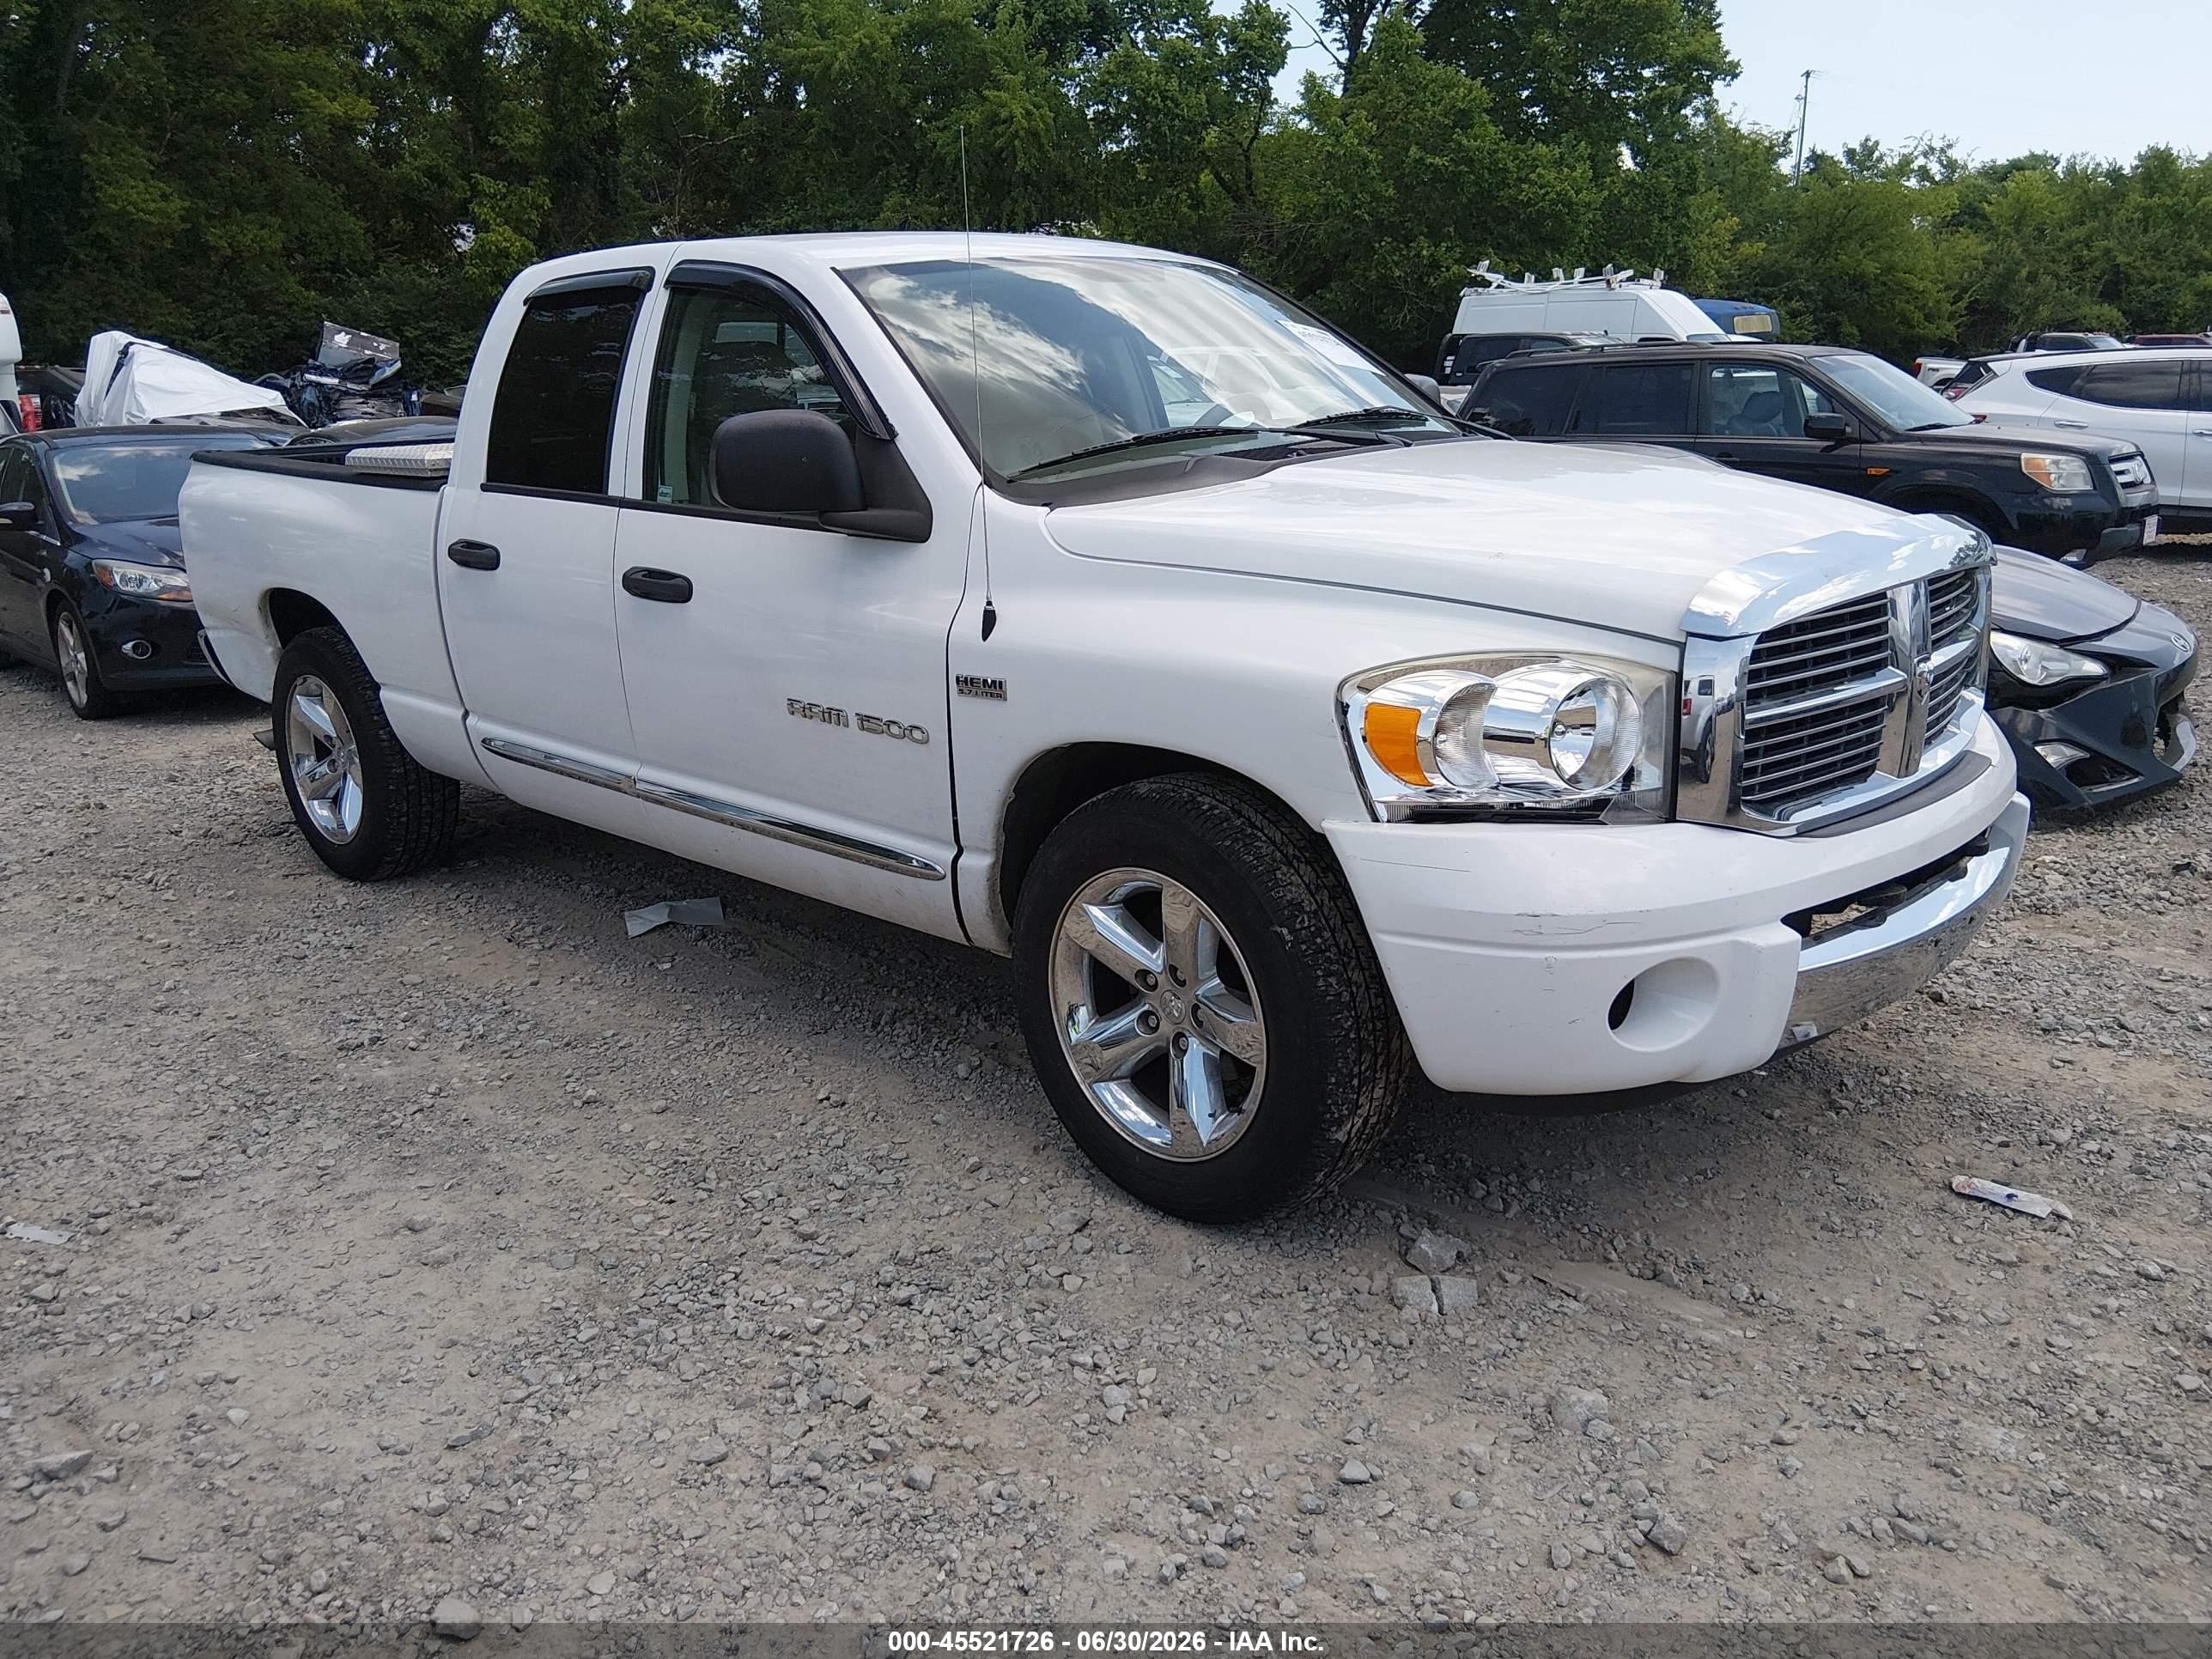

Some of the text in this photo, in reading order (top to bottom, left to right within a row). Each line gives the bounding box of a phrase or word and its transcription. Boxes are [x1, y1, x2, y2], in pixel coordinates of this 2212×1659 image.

[955, 674, 1005, 690] HEMI
[787, 697, 930, 744] RAM 1500
